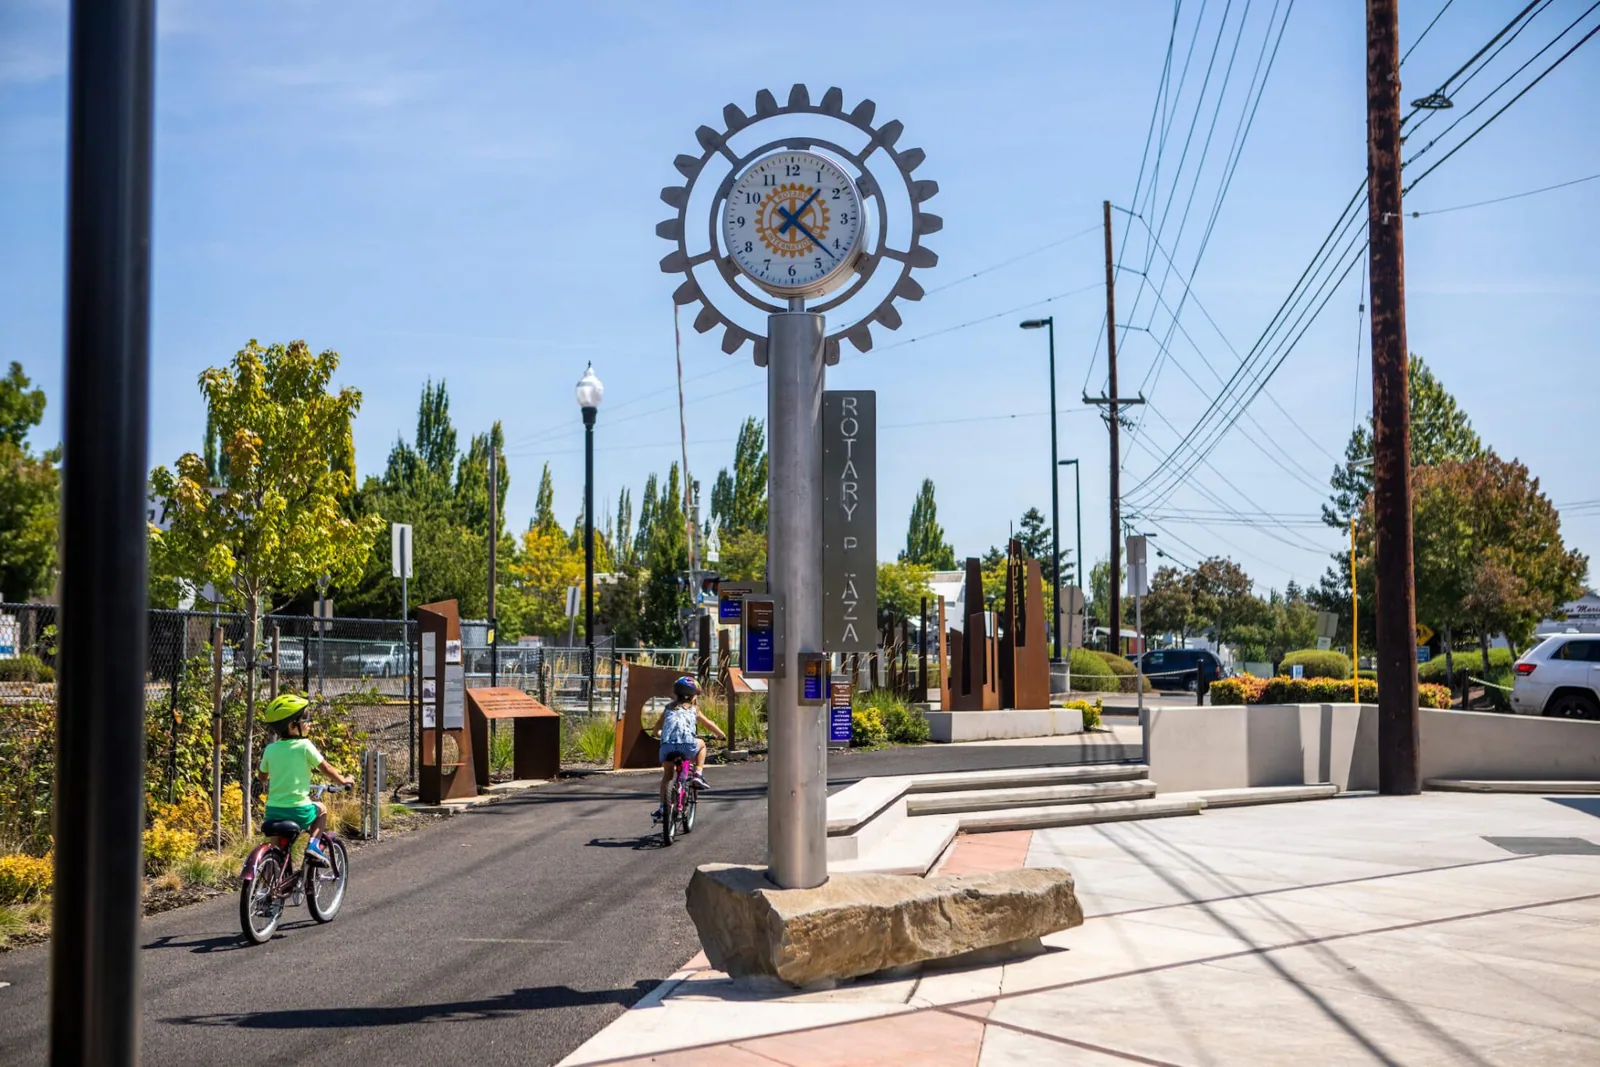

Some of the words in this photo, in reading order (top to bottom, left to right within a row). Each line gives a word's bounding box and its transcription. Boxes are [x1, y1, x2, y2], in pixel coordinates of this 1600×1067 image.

[785, 164, 801, 177] 12
[763, 174, 776, 187] 11
[816, 171, 822, 183] 1
[745, 192, 761, 204] 10
[832, 188, 841, 200] 2
[737, 216, 746, 228] 9
[840, 213, 848, 225] 3
[744, 241, 753, 253] 8
[832, 238, 841, 250] 4
[763, 259, 771, 271] 7
[814, 257, 822, 269] 5
[787, 265, 797, 277] 6
[840, 397, 859, 522] ROTARY
